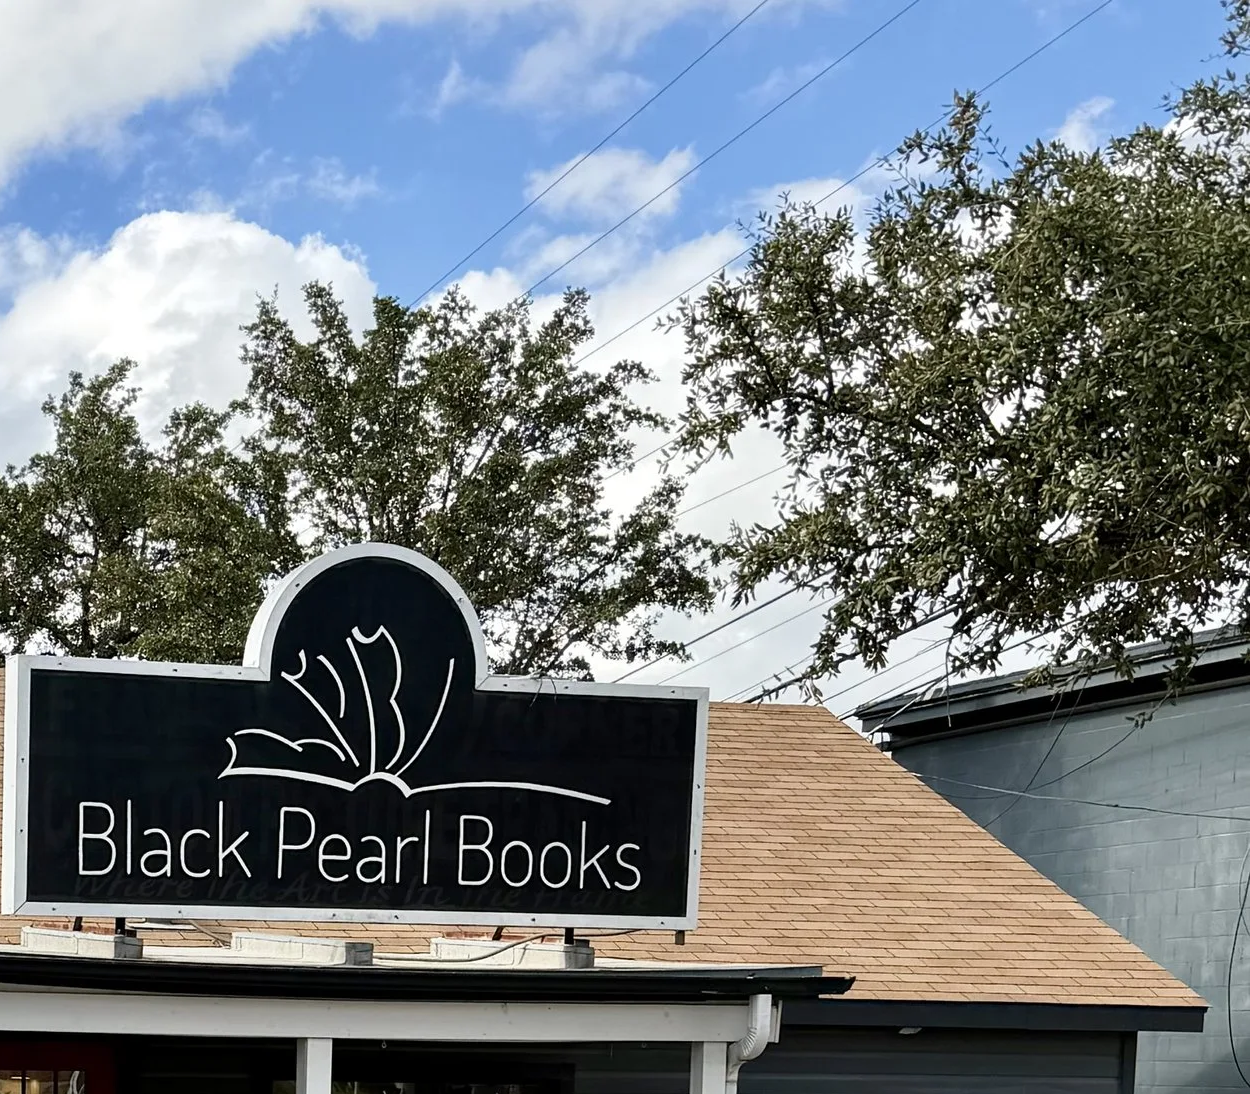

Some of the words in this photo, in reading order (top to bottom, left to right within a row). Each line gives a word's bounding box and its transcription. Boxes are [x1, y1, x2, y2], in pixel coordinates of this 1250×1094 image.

[78, 799, 252, 878] Black
[277, 806, 431, 885] Pearl
[457, 814, 642, 891] Books
